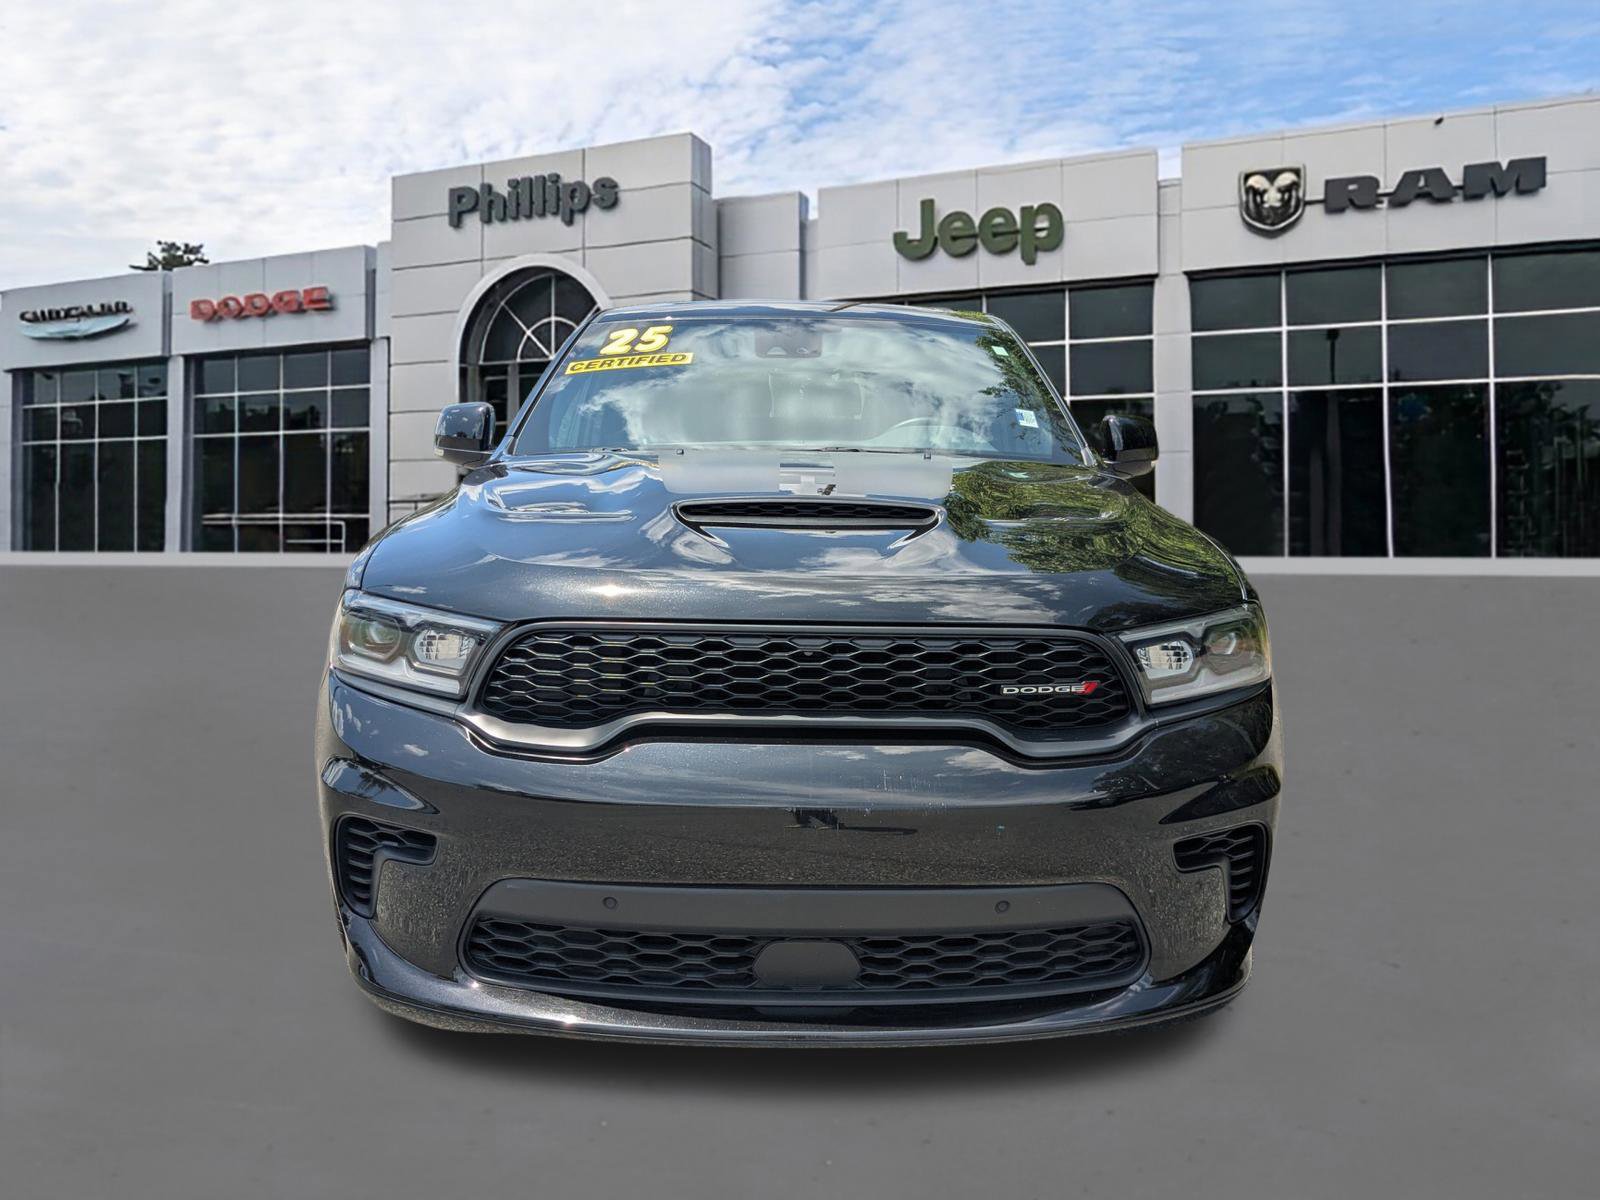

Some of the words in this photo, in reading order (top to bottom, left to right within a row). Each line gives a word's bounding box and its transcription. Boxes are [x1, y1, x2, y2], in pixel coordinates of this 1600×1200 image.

[448, 172, 619, 228] Phillips
[1324, 156, 1547, 214] RAM
[893, 198, 1064, 266] Jeep
[190, 286, 332, 323] DODGE
[600, 325, 673, 354] 25
[569, 353, 688, 372] CERTIFIED
[1002, 685, 1086, 694] DODGE
